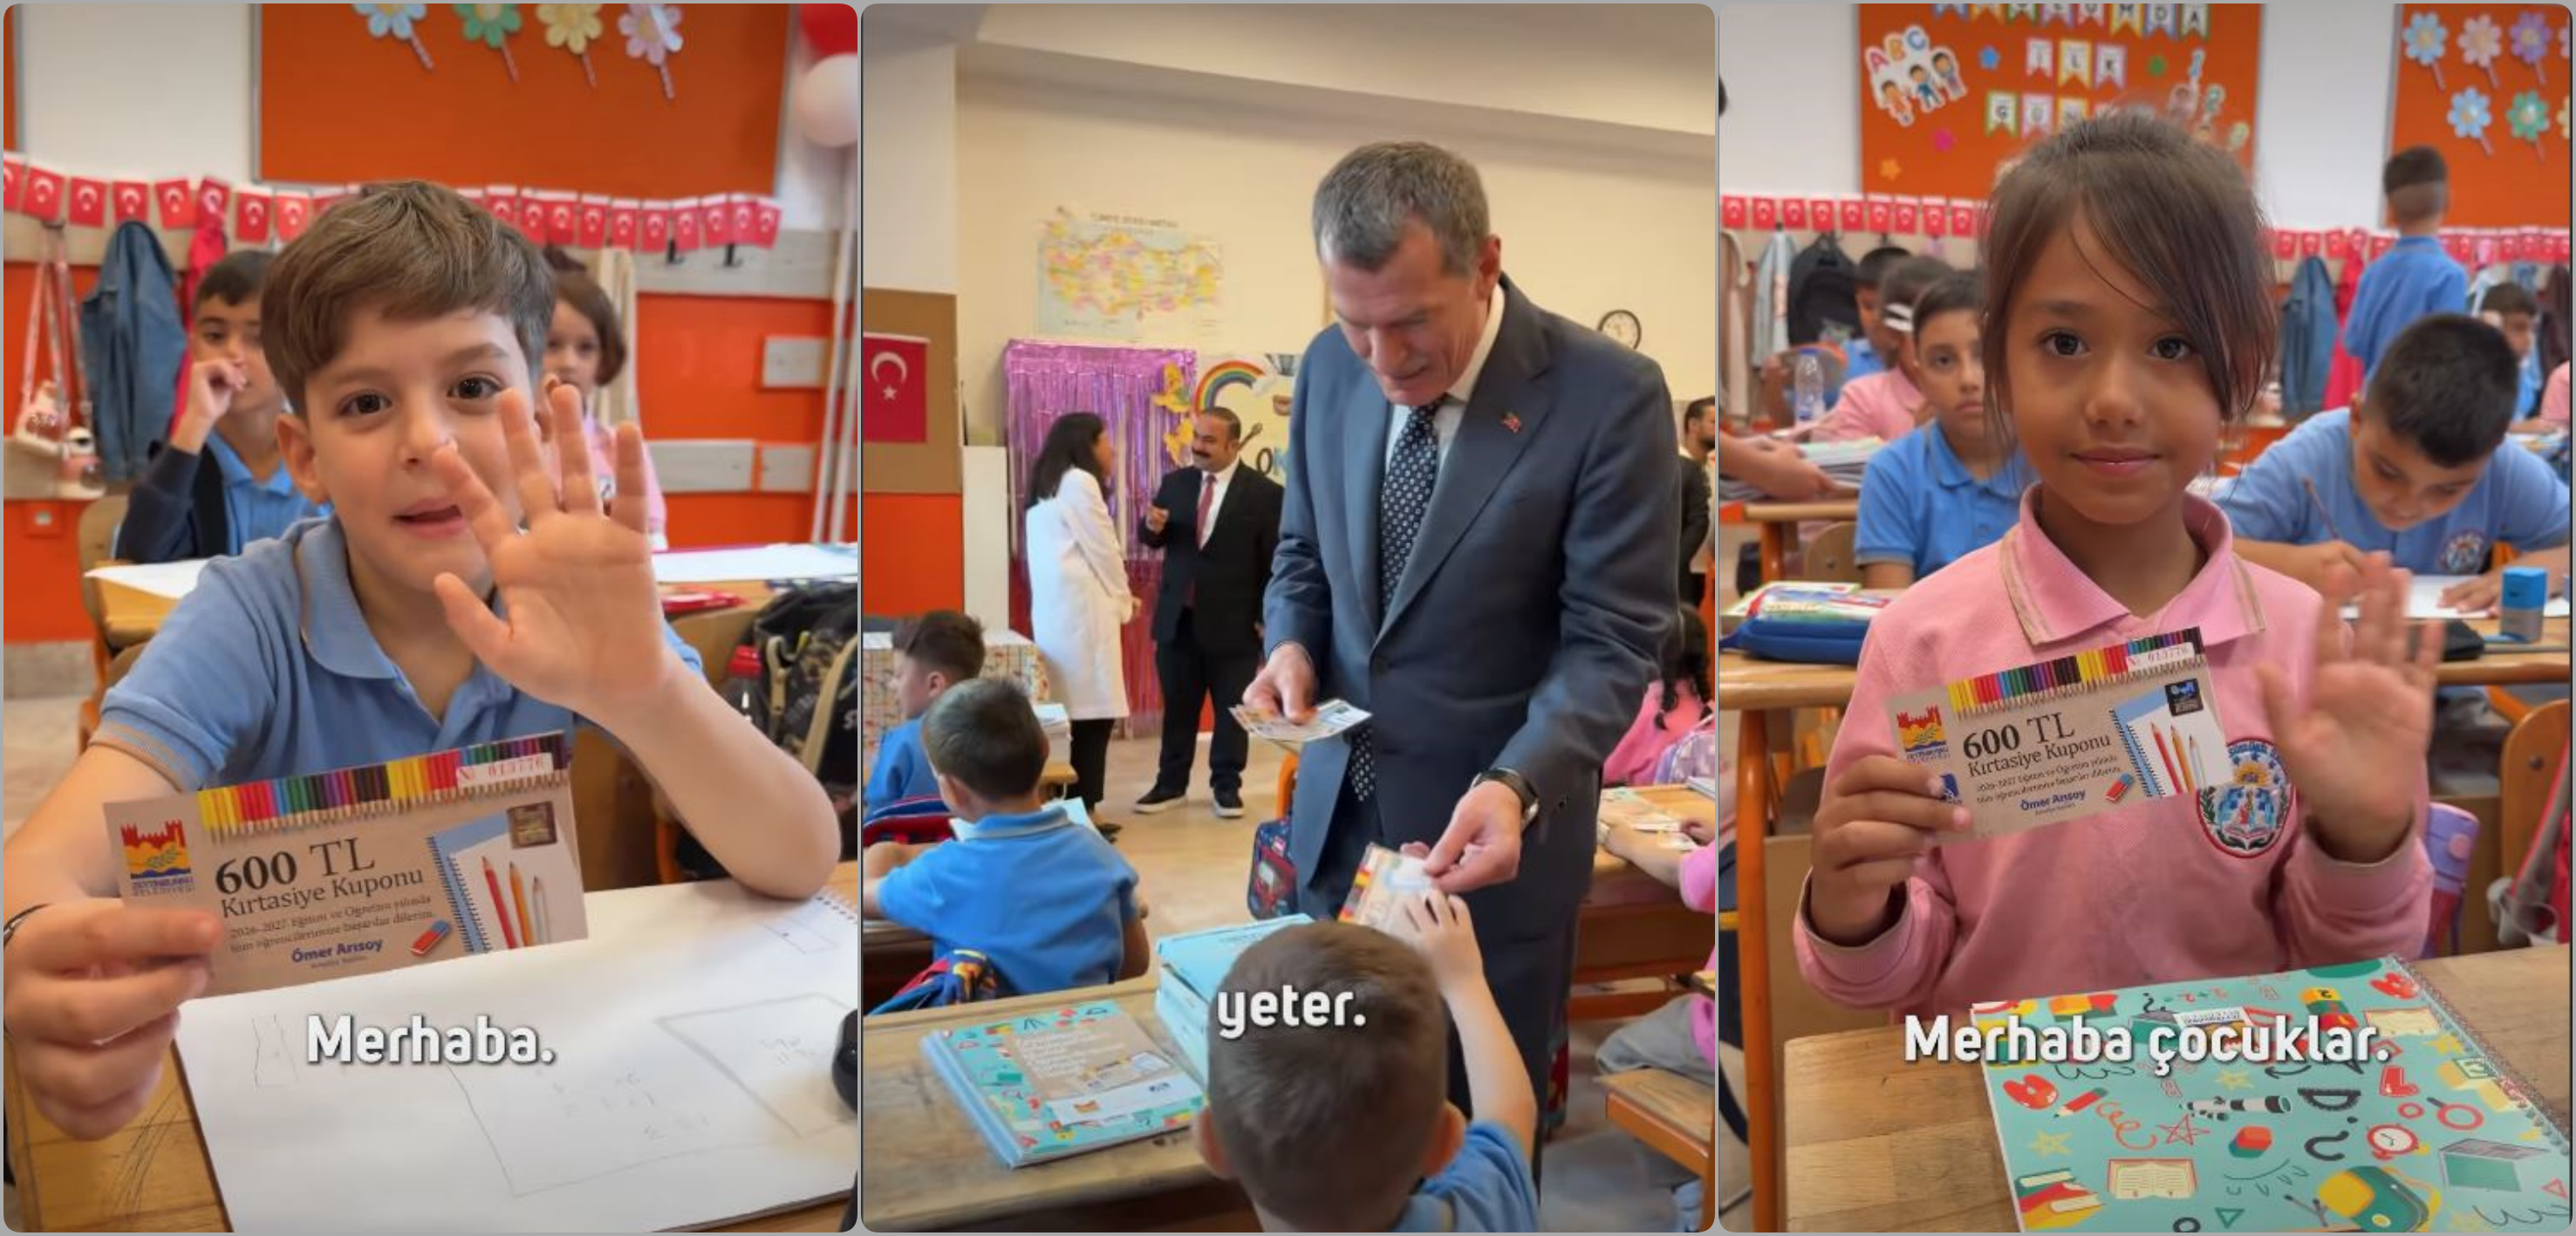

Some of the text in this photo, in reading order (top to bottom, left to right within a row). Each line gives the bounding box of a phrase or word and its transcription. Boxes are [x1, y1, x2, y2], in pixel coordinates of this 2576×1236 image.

[1963, 712, 2075, 760] 600 TL
[1967, 734, 2111, 777] Kırtasiye Kuponu
[2019, 797, 2050, 811] Ömer
[215, 837, 376, 896] 600 TL
[221, 869, 424, 918] Kırtasiye Kuponu
[290, 946, 332, 964] Ömer
[335, 939, 384, 956] Arısoy
